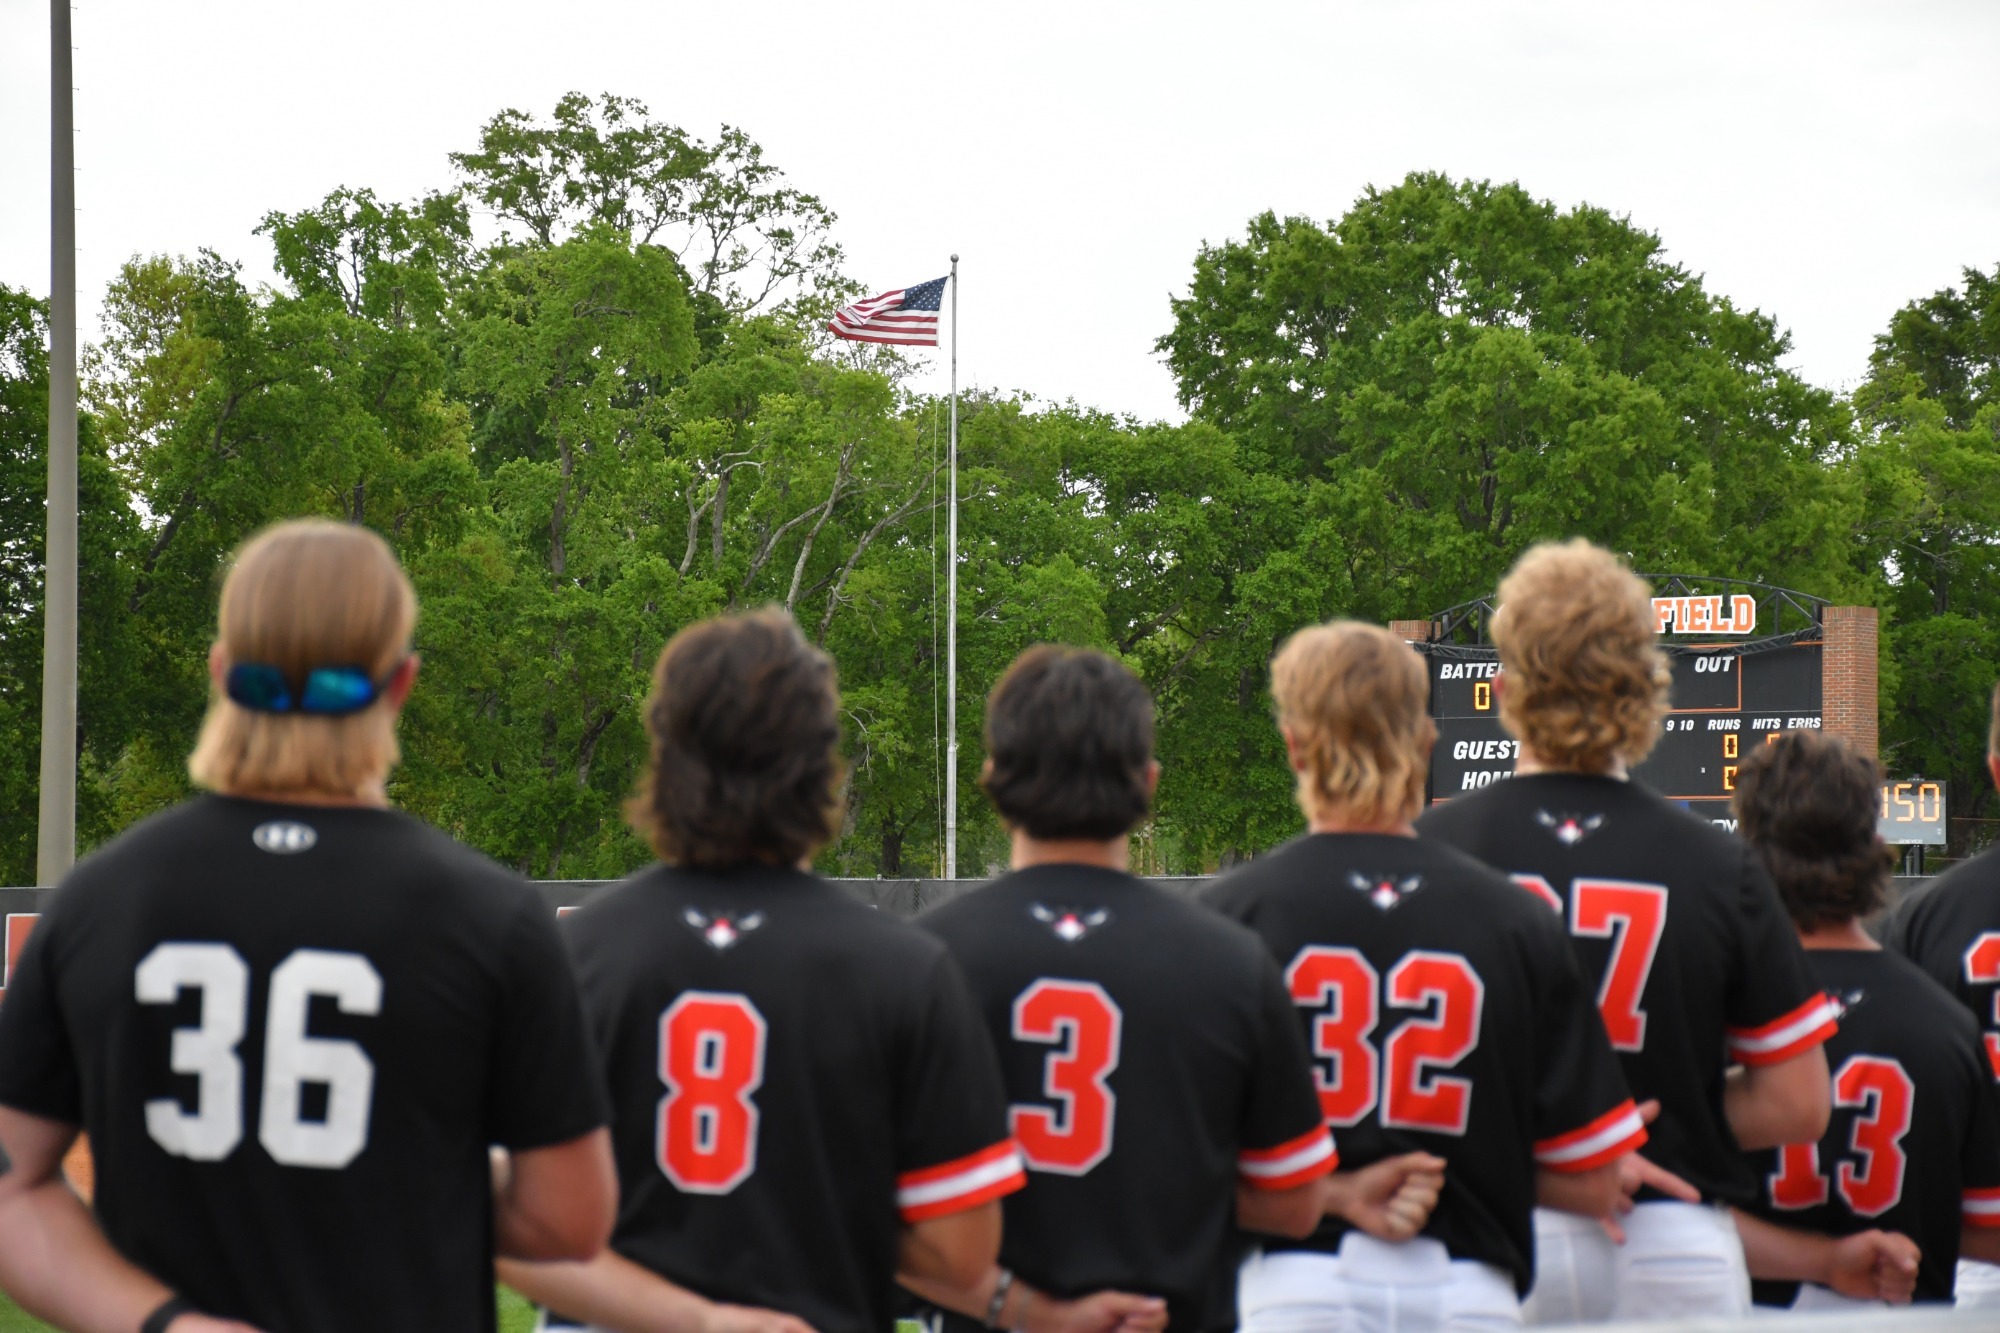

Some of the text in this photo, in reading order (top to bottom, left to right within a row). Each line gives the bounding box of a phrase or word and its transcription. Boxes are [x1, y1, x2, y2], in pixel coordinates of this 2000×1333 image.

[1652, 595, 1755, 634] FIELD
[1695, 656, 1735, 673] OUT
[1474, 682, 1491, 710] 0
[1666, 717, 1821, 731] 9 10 RUNS HITS ERRS
[1723, 734, 1738, 758] 0
[1883, 783, 1940, 822] 150
[134, 942, 384, 1169] 36
[1285, 944, 1485, 1136] 32
[656, 990, 767, 1195] 8
[1007, 976, 1123, 1176] 3
